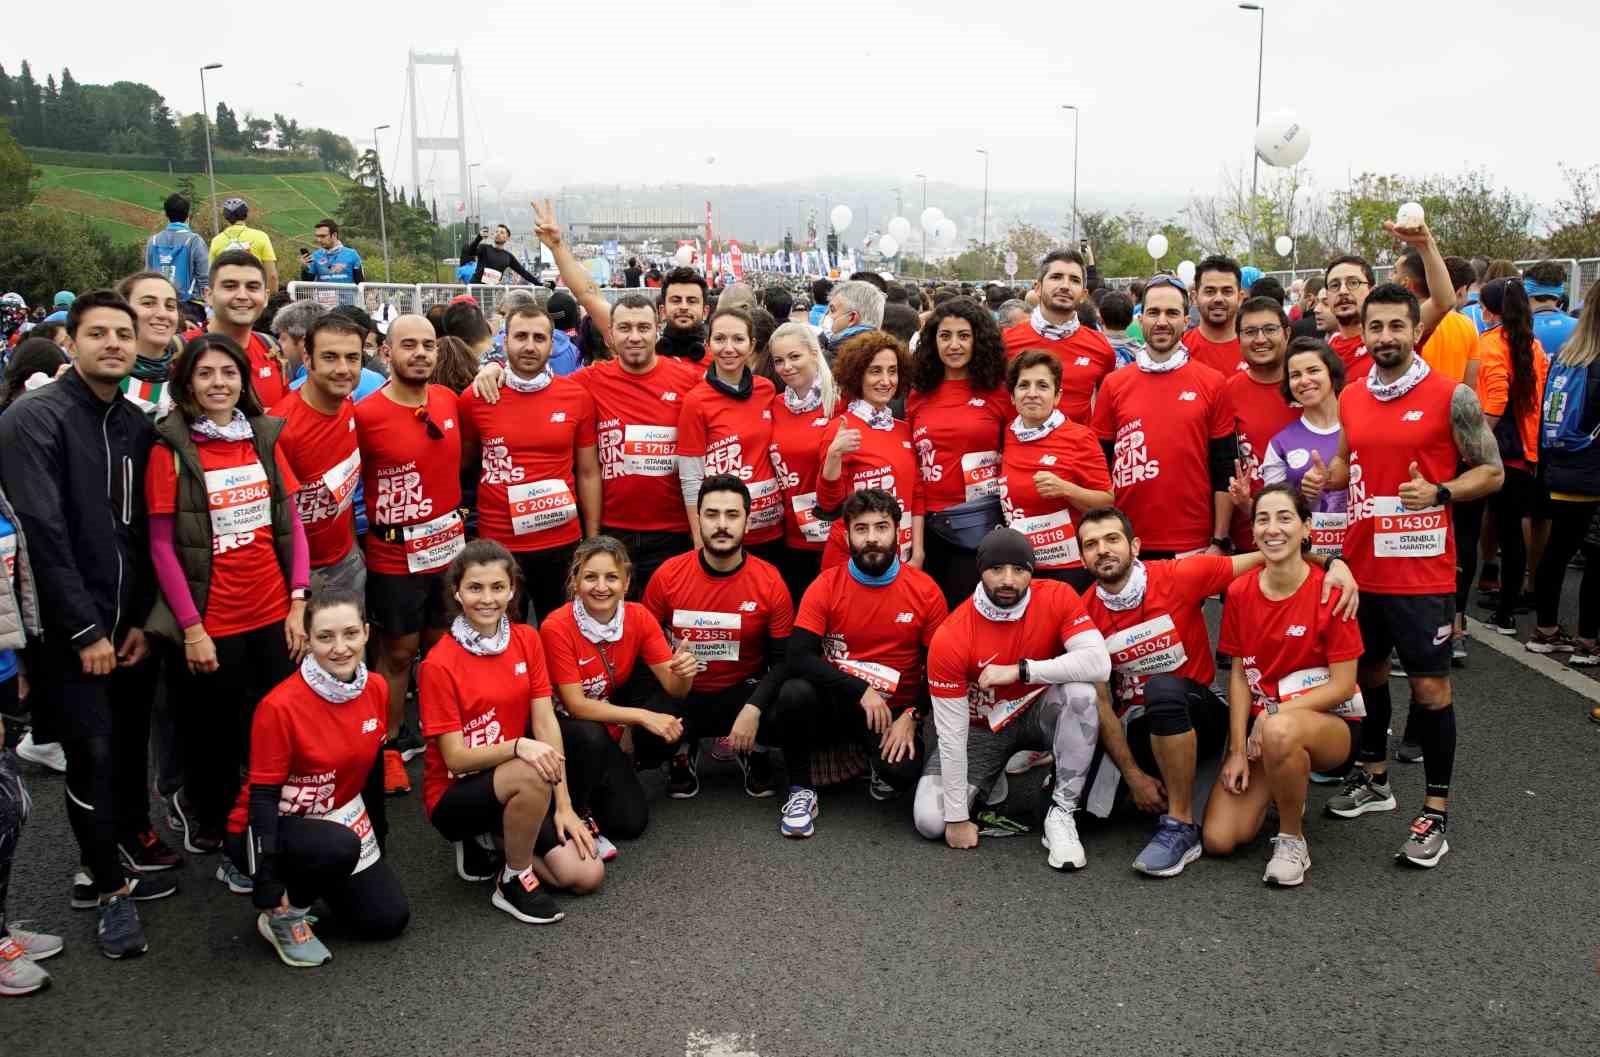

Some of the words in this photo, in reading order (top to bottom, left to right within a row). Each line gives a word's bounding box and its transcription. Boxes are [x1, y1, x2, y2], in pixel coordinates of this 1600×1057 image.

[1401, 411, 1424, 421] NB
[634, 442, 643, 453] E
[646, 443, 677, 455] 17187
[377, 461, 417, 478] AKBANK
[853, 465, 892, 481] AKBANK
[1111, 459, 1160, 489] NERS
[377, 472, 422, 494] RED
[209, 493, 224, 506] G
[227, 485, 268, 504] 23846
[376, 485, 424, 508] RUN
[376, 498, 433, 526] NERS
[515, 502, 526, 513] G
[530, 496, 569, 511] 20966
[805, 510, 813, 519] E
[1382, 518, 1393, 529] D
[1397, 515, 1441, 530] 14307
[1031, 529, 1064, 545] 18118
[1399, 535, 1436, 543] ISTANBUL
[737, 601, 757, 612] NB
[895, 612, 914, 623] NB
[695, 630, 733, 641] 23551
[1284, 624, 1307, 637] NB
[1117, 651, 1129, 661] D
[1131, 635, 1172, 659] 15047
[362, 718, 378, 734] NB
[287, 770, 337, 784] AKBANK
